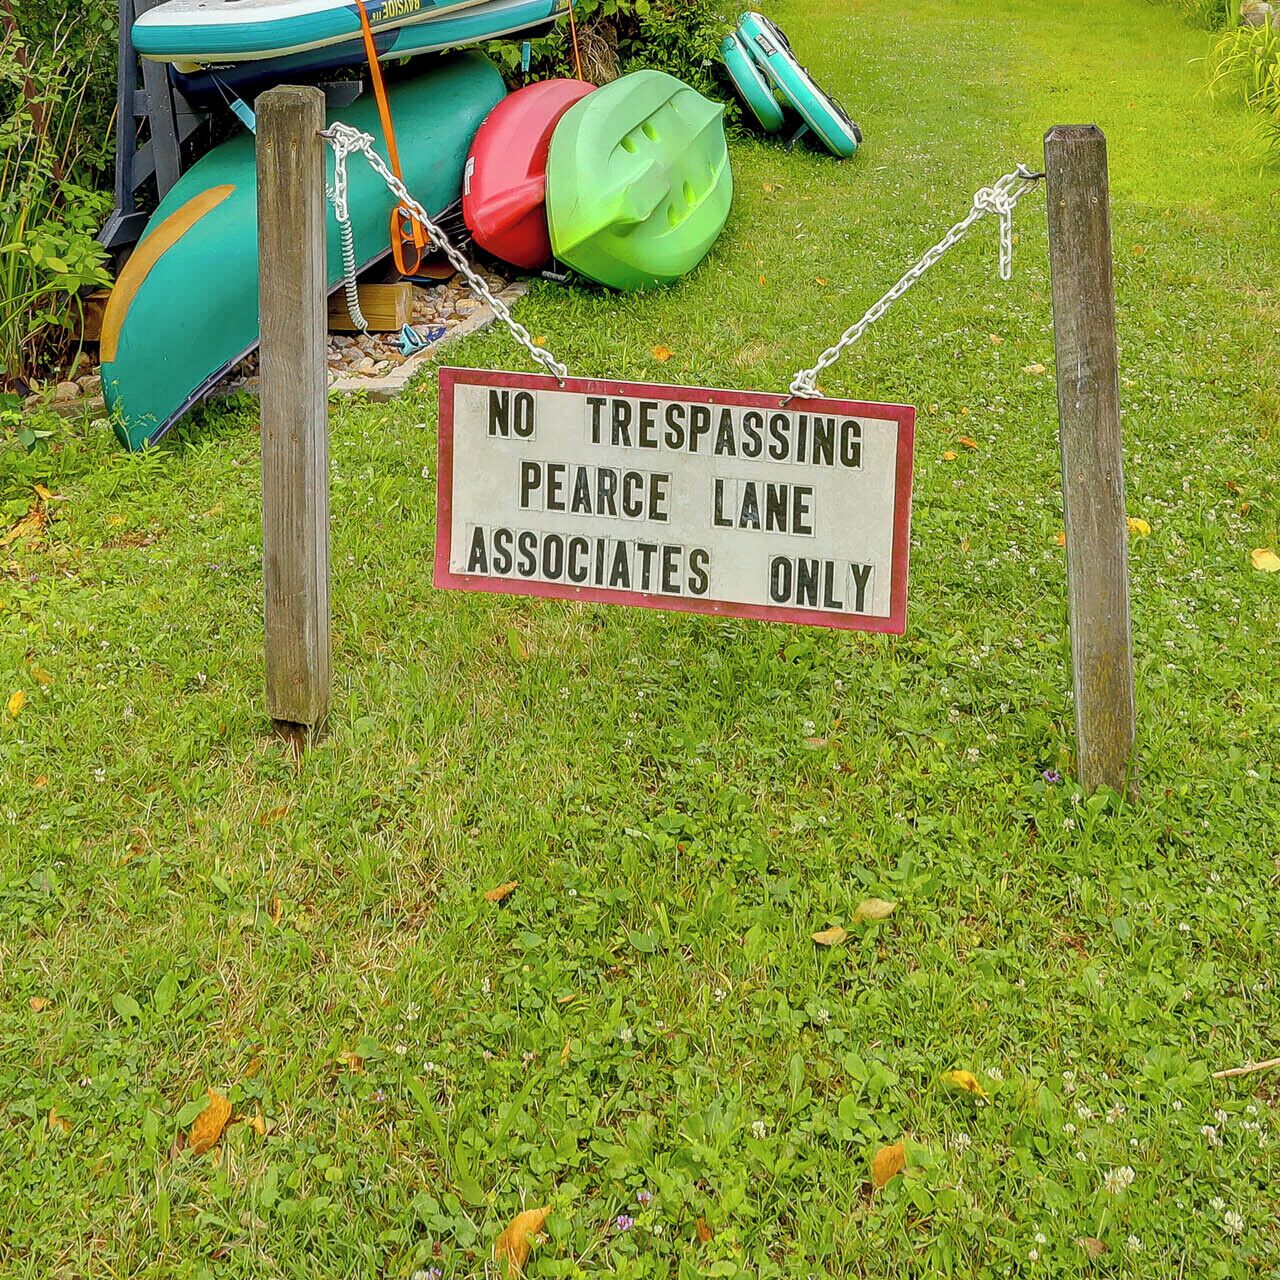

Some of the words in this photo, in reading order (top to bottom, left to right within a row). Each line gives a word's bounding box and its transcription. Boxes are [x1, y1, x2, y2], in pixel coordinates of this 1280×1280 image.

[488, 389, 535, 438] NO
[586, 396, 862, 468] TRESPASSING
[520, 461, 670, 522] PEARCE
[714, 478, 813, 535] LANE
[467, 526, 711, 595] ASSOCIATES
[770, 556, 873, 613] ONLY
